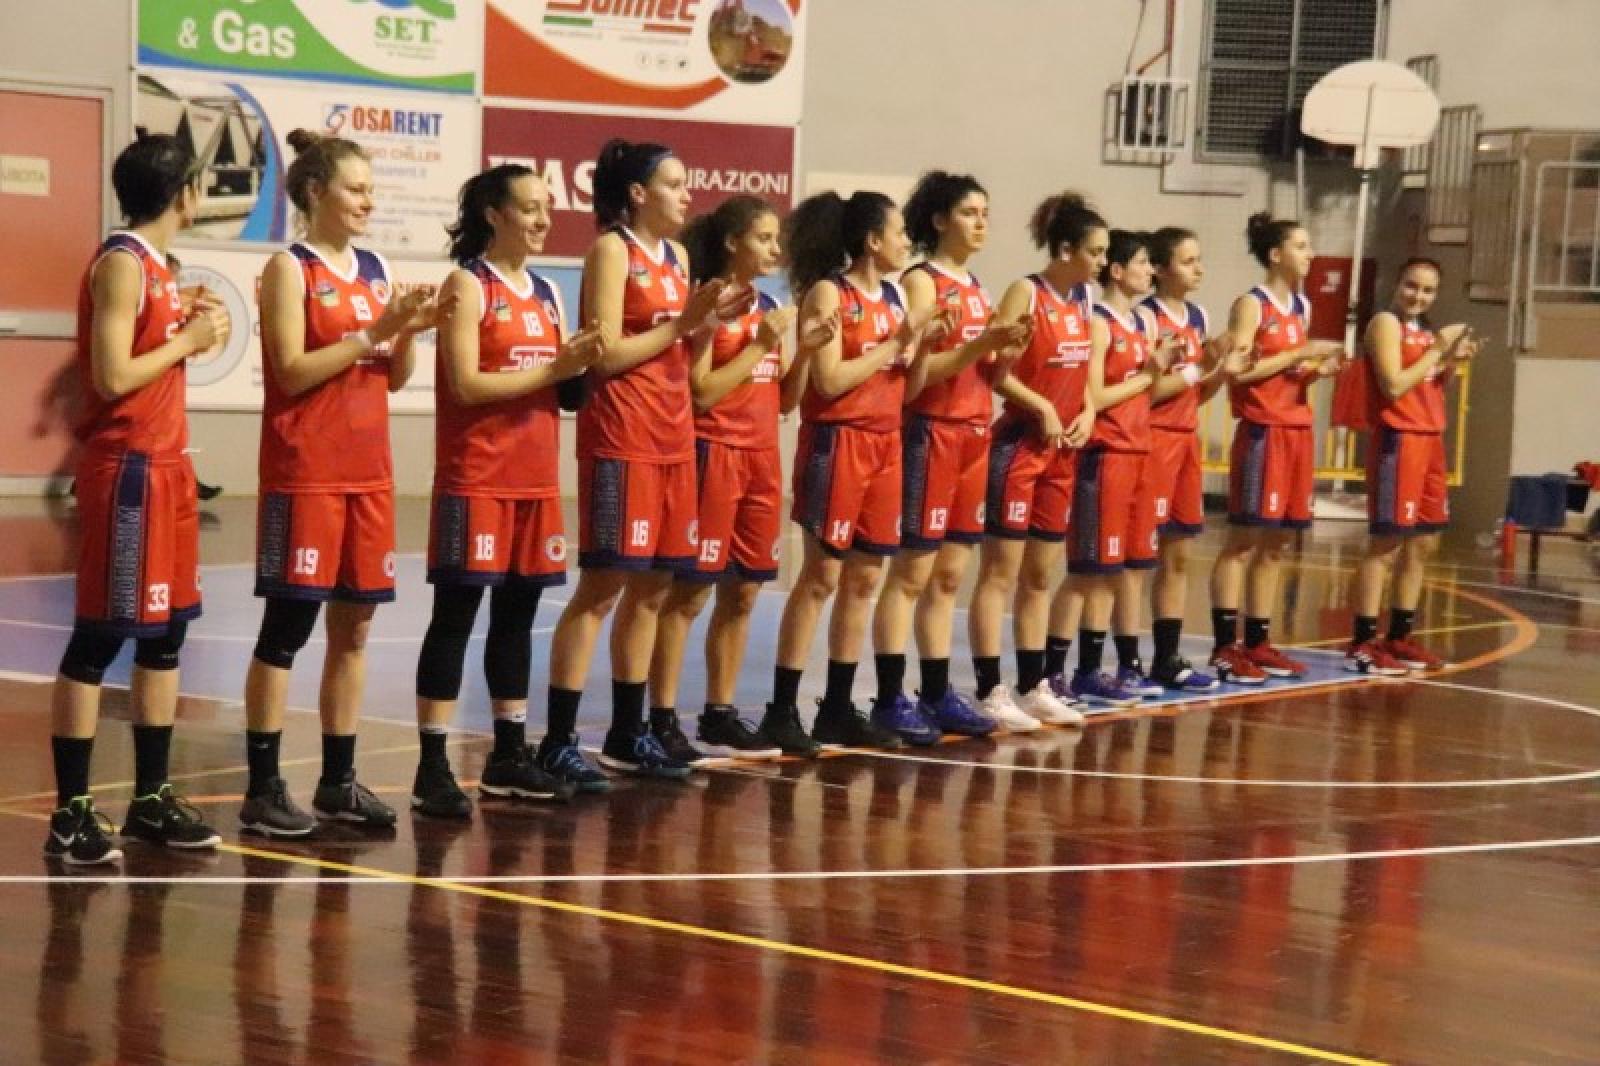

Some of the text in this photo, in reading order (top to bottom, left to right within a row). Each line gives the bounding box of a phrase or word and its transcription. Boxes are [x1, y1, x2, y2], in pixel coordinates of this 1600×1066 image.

[177, 9, 296, 59] & Gas
[375, 15, 437, 42] SET
[351, 105, 443, 137] OSARENT
[929, 507, 948, 531] 13
[1007, 501, 1027, 523] 12
[631, 519, 649, 547] 16
[831, 519, 851, 541] 14
[475, 533, 496, 561] 18
[699, 539, 721, 563] 15
[294, 547, 320, 576] 19
[147, 583, 170, 612] 33
